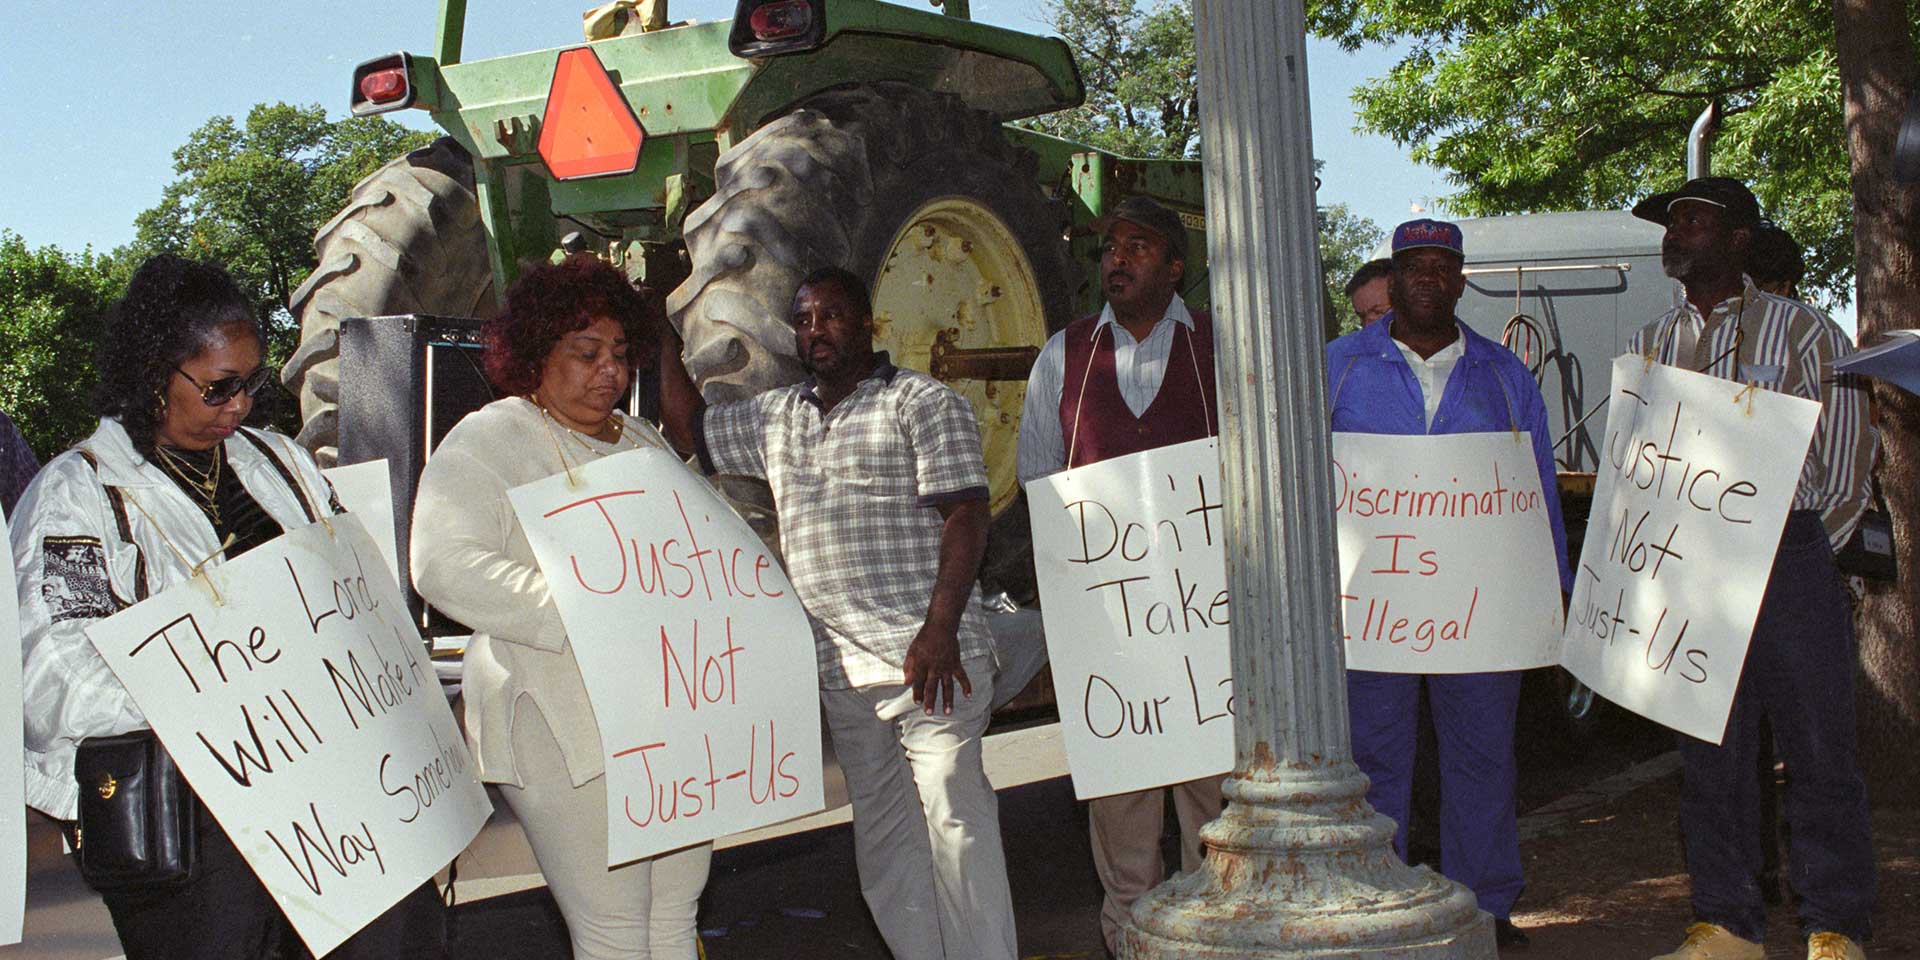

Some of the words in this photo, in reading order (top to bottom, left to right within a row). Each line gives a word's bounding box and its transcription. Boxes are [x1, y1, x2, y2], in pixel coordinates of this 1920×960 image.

[1610, 389, 1758, 525] Justice
[543, 489, 784, 601] Justice
[1064, 474, 1223, 564] Don't
[1371, 534, 1439, 576] Is
[1609, 508, 1683, 580] Not
[129, 612, 281, 693] The
[284, 543, 379, 634] Lord
[1085, 568, 1231, 638] Take
[1574, 564, 1709, 684] Just-Us
[196, 689, 323, 788] Will
[322, 634, 412, 729] Make
[393, 624, 428, 687] A
[660, 616, 745, 711] Not
[1085, 675, 1170, 739] Our
[613, 719, 800, 828] Just-Us
[265, 802, 385, 896] Way
